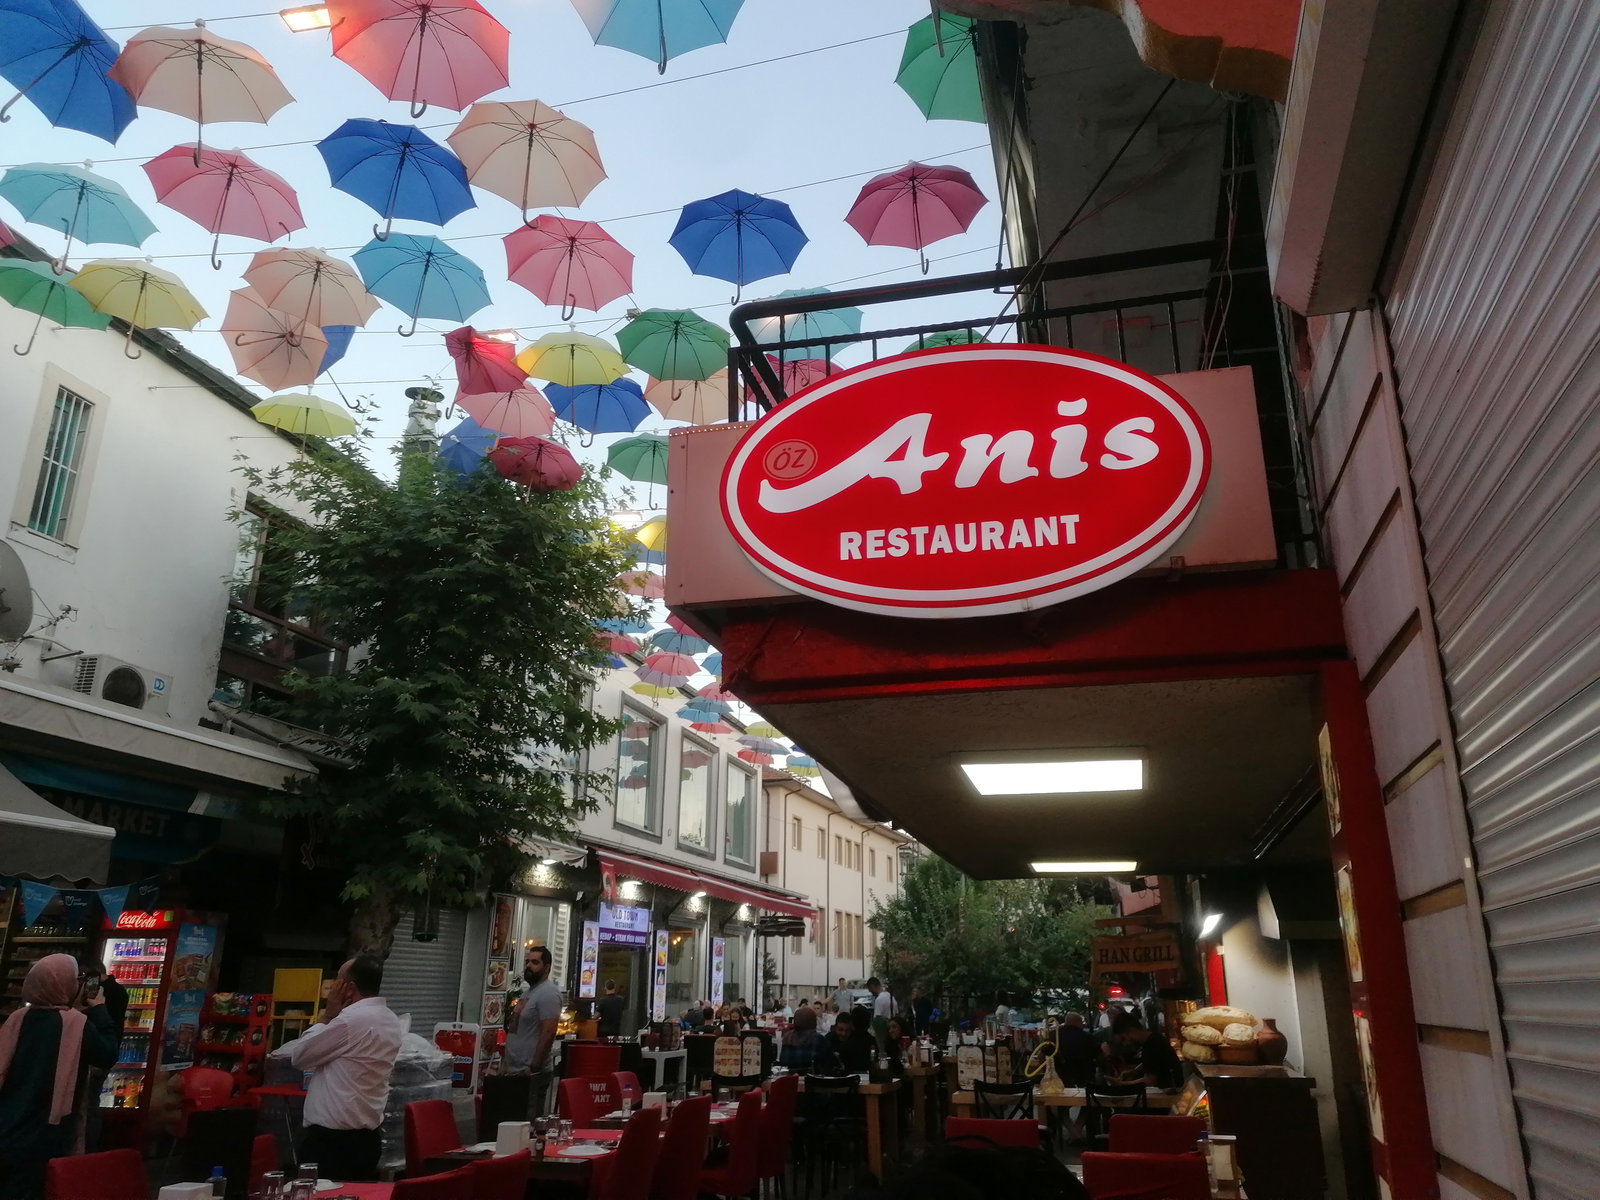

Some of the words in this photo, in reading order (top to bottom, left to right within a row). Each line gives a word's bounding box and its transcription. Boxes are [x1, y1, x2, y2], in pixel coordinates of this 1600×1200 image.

[758, 397, 1160, 513] Anis
[772, 444, 807, 472] ÖZ
[839, 514, 1080, 561] RESTAURANT
[63, 795, 171, 837] MARKET
[116, 910, 160, 928] Coca-Cola
[1099, 947, 1130, 964] HAN
[1133, 945, 1175, 962] GRILL
